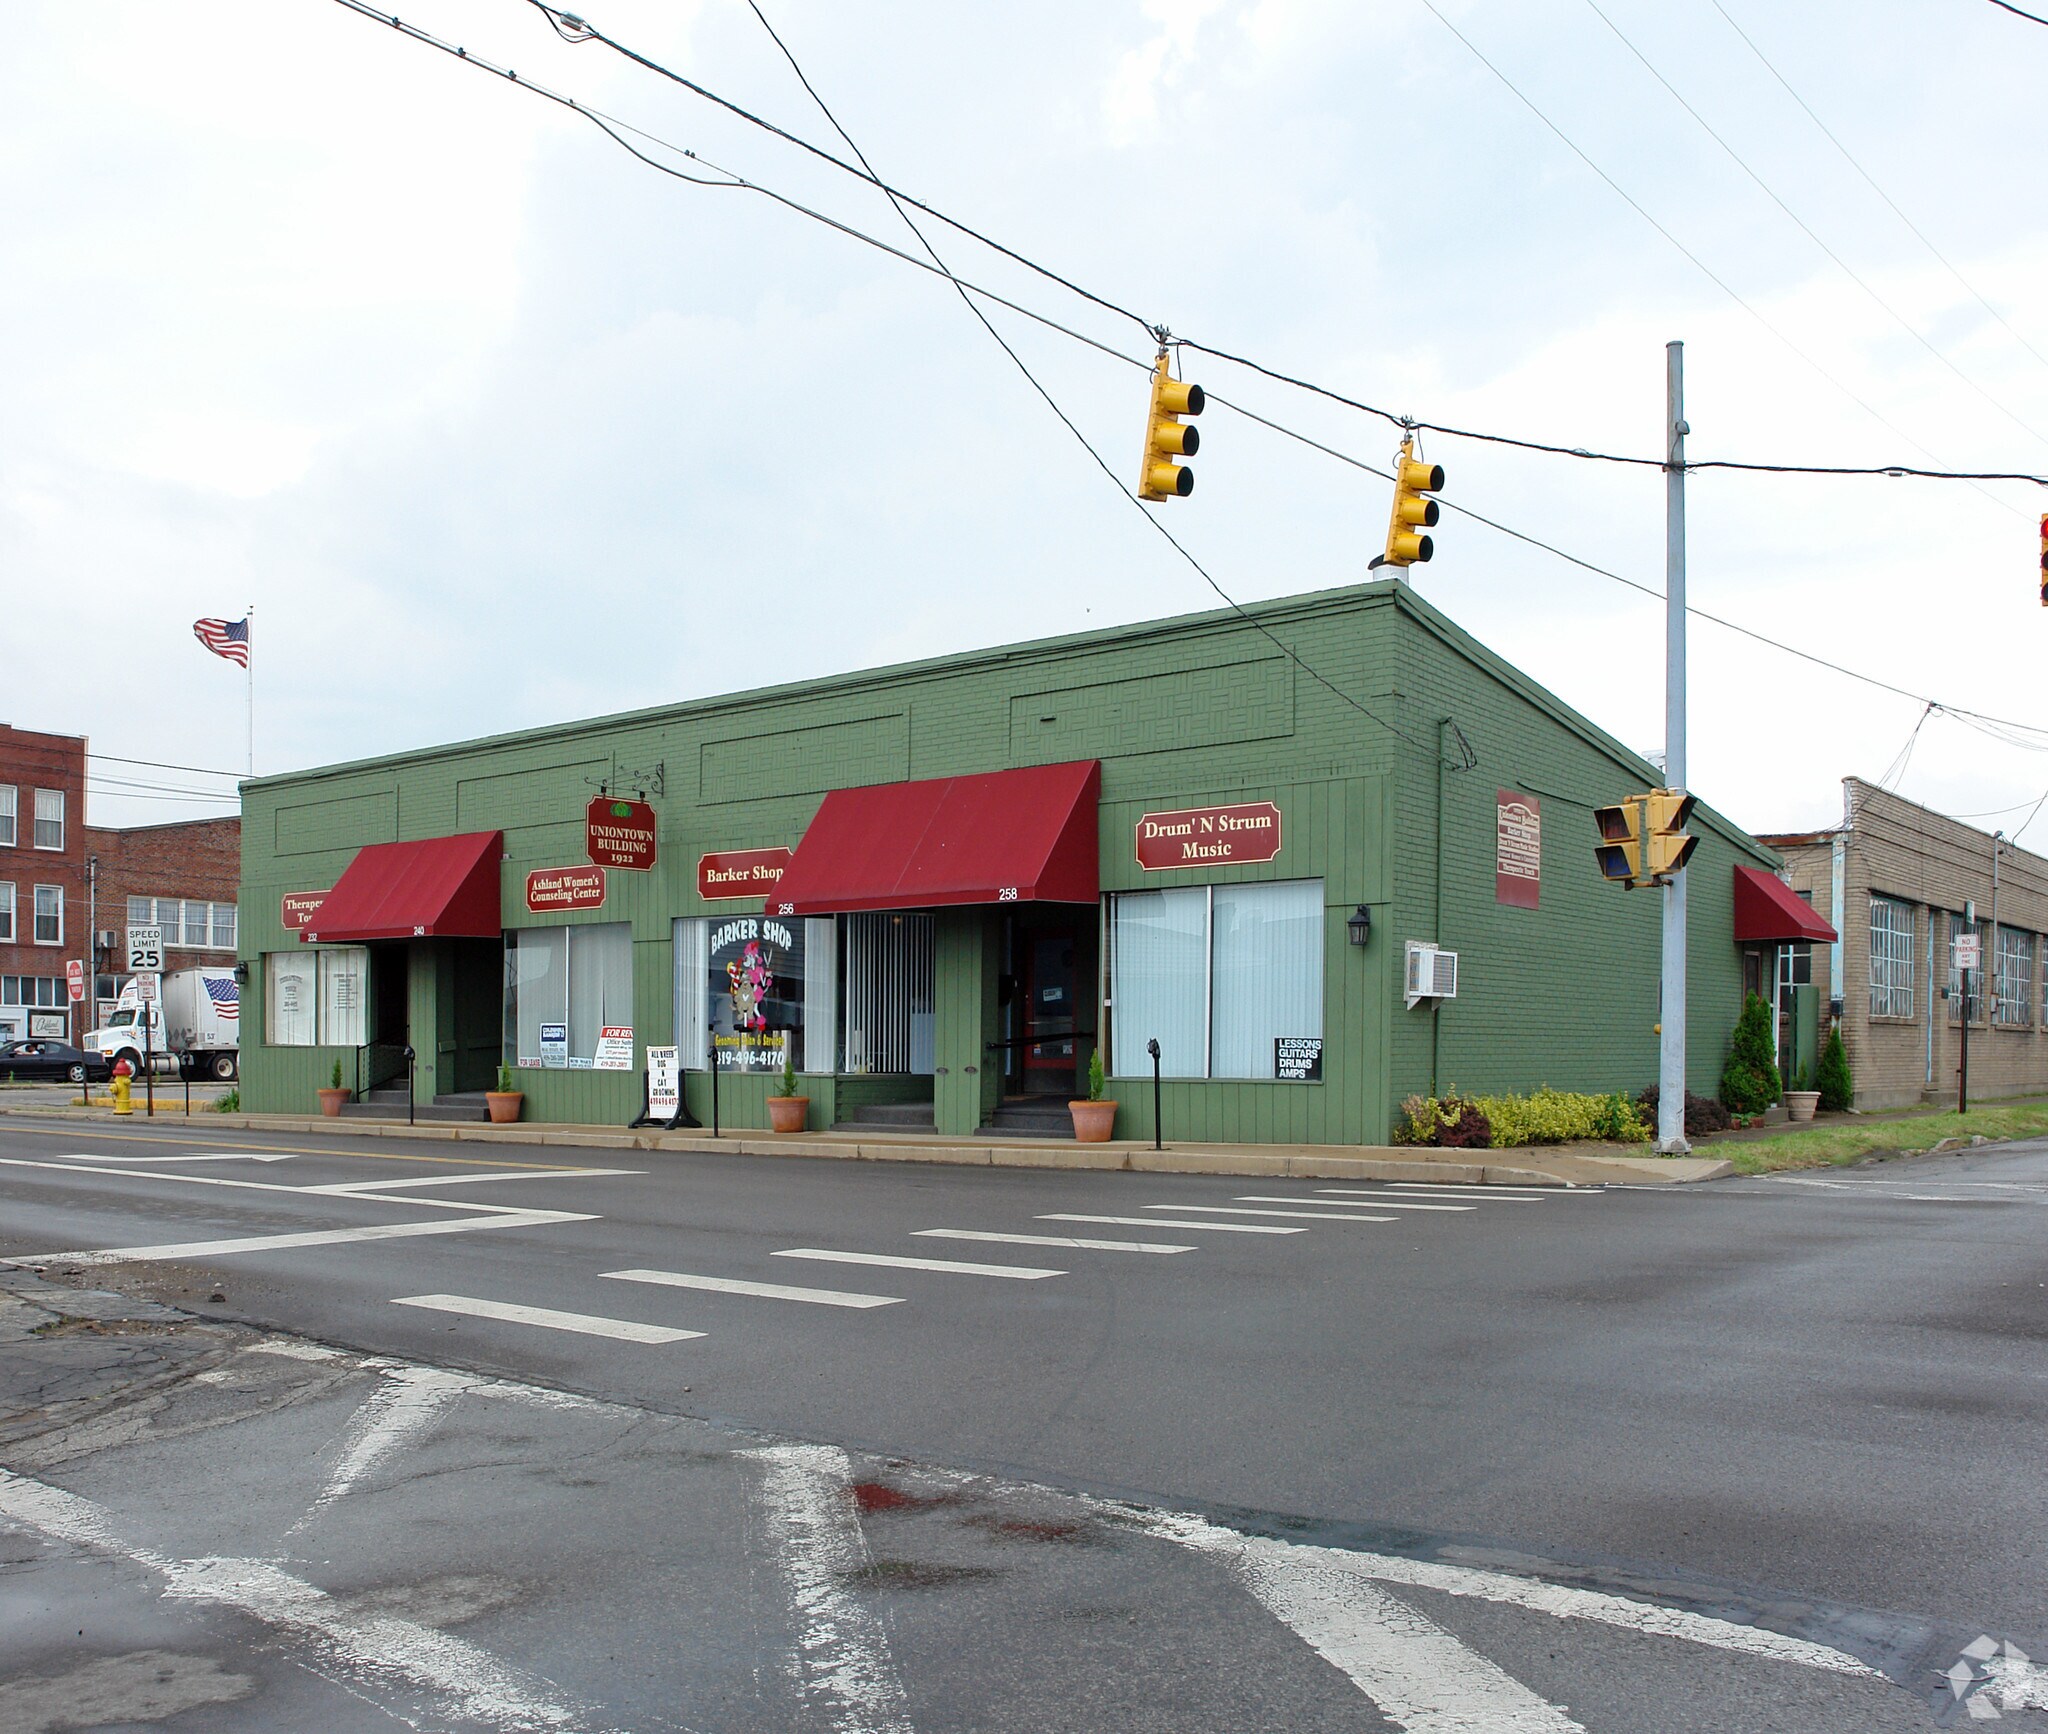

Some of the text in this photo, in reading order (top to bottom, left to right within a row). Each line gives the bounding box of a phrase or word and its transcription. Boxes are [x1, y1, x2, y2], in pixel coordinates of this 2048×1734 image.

[1144, 815, 1272, 838] Drum' N Strum
[590, 825, 653, 841] UNIONTOWN
[597, 838, 647, 853] BUILDING
[1182, 840, 1231, 859] Music
[611, 853, 633, 864] 1922
[707, 865, 784, 882] Barker Shop
[532, 875, 599, 890] Ashland Women's
[530, 887, 600, 902] Counseling Center
[998, 887, 1018, 900] 258
[778, 903, 794, 915] 256
[129, 930, 160, 938] SPEED
[413, 926, 425, 935] 240
[307, 933, 317, 942] 232
[711, 918, 792, 956] BARKER SHOP
[133, 940, 156, 948] LIMIT
[131, 950, 159, 967] 25
[606, 1029, 620, 1037] FOR
[715, 1034, 740, 1048] Grooming
[1279, 1039, 1322, 1050] LESSONS
[651, 1050, 659, 1058] ALL
[1278, 1049, 1318, 1059] GUITARS
[657, 1060, 667, 1068] DOG
[1279, 1058, 1313, 1069] DRUMS
[1278, 1068, 1306, 1079] AMPS
[657, 1079, 667, 1087] CAT
[652, 1088, 676, 1096] GROOMING
